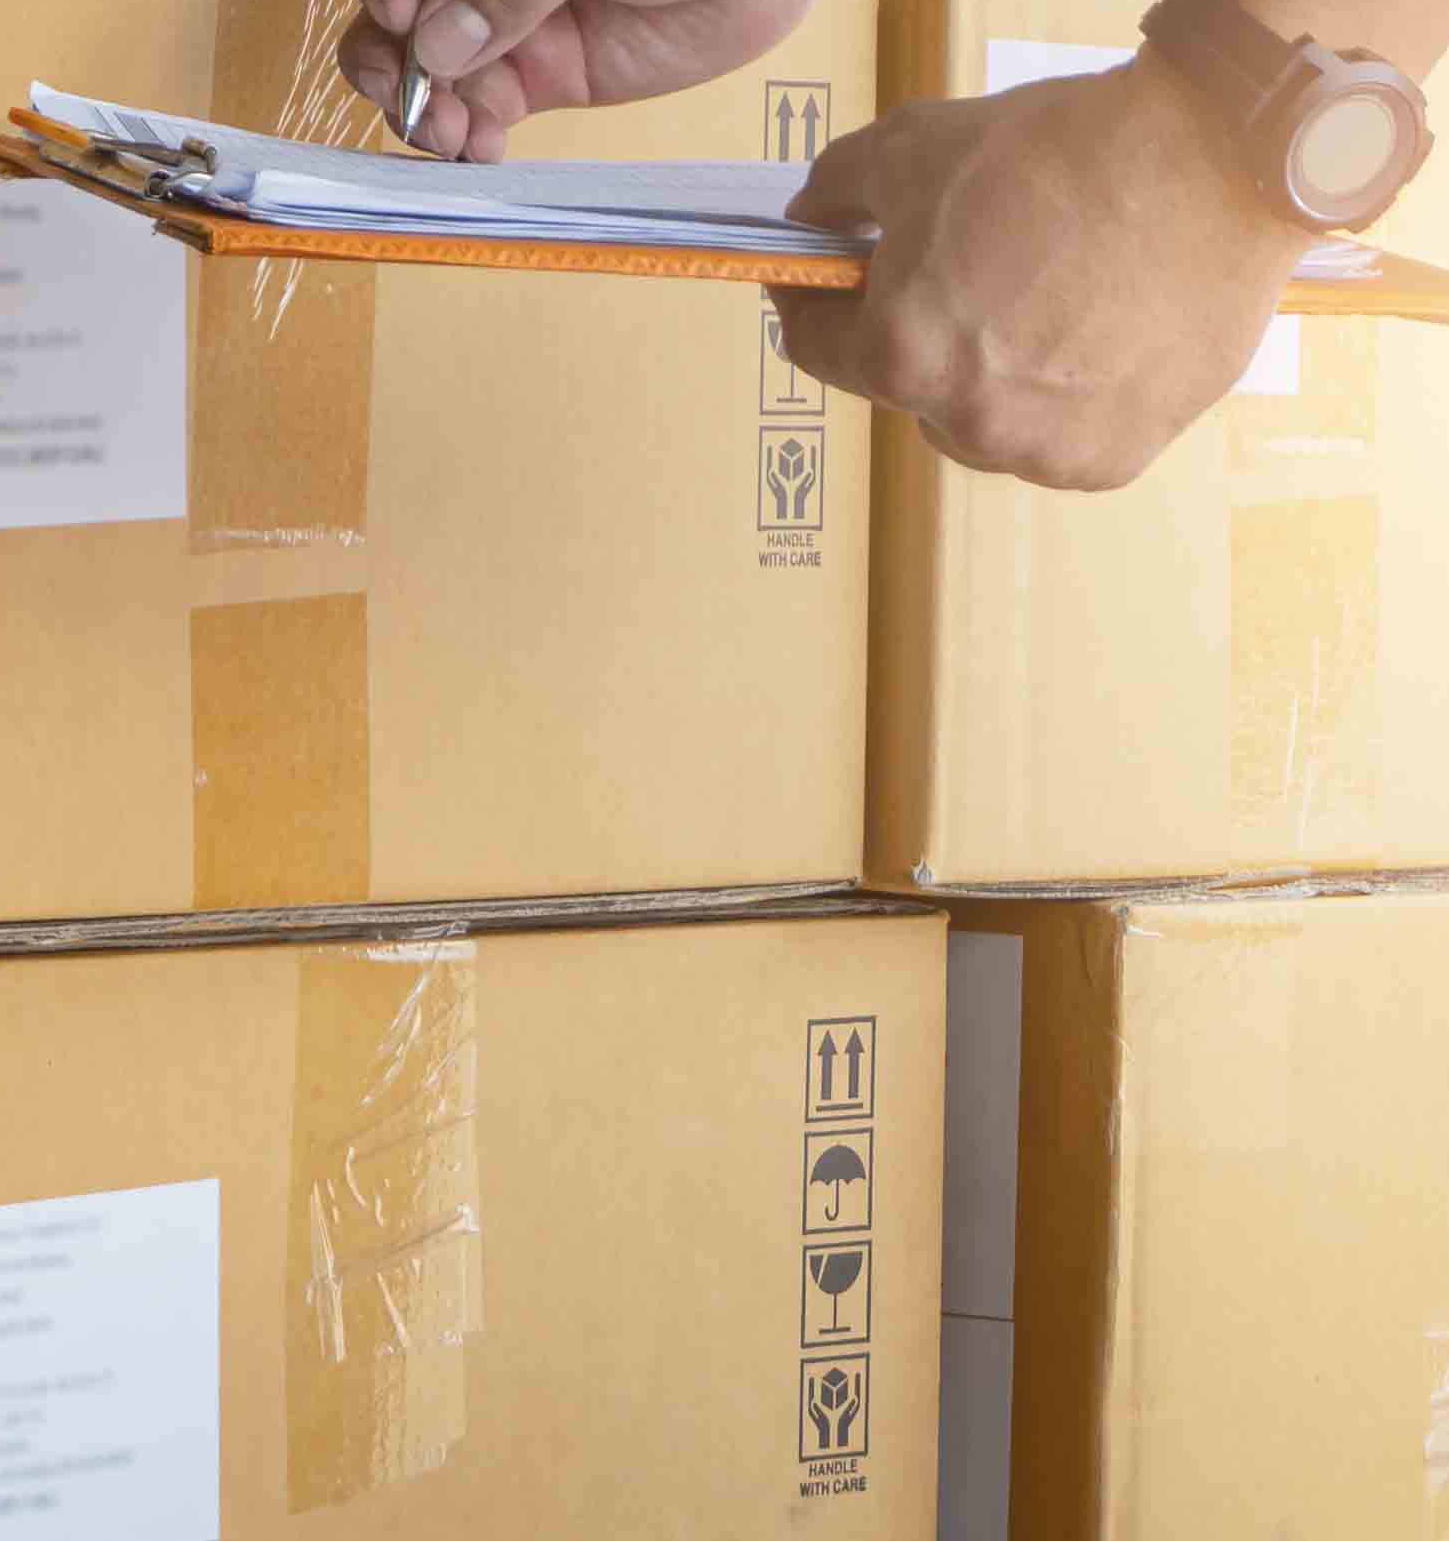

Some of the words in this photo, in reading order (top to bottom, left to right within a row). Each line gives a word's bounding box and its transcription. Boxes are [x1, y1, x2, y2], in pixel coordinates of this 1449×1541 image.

[767, 532, 814, 547] HANDLE
[758, 552, 787, 567] WITH
[790, 551, 822, 566] CARE
[808, 1459, 857, 1476] HANDLE
[799, 1481, 829, 1496] WITH
[833, 1476, 866, 1493] CARE
